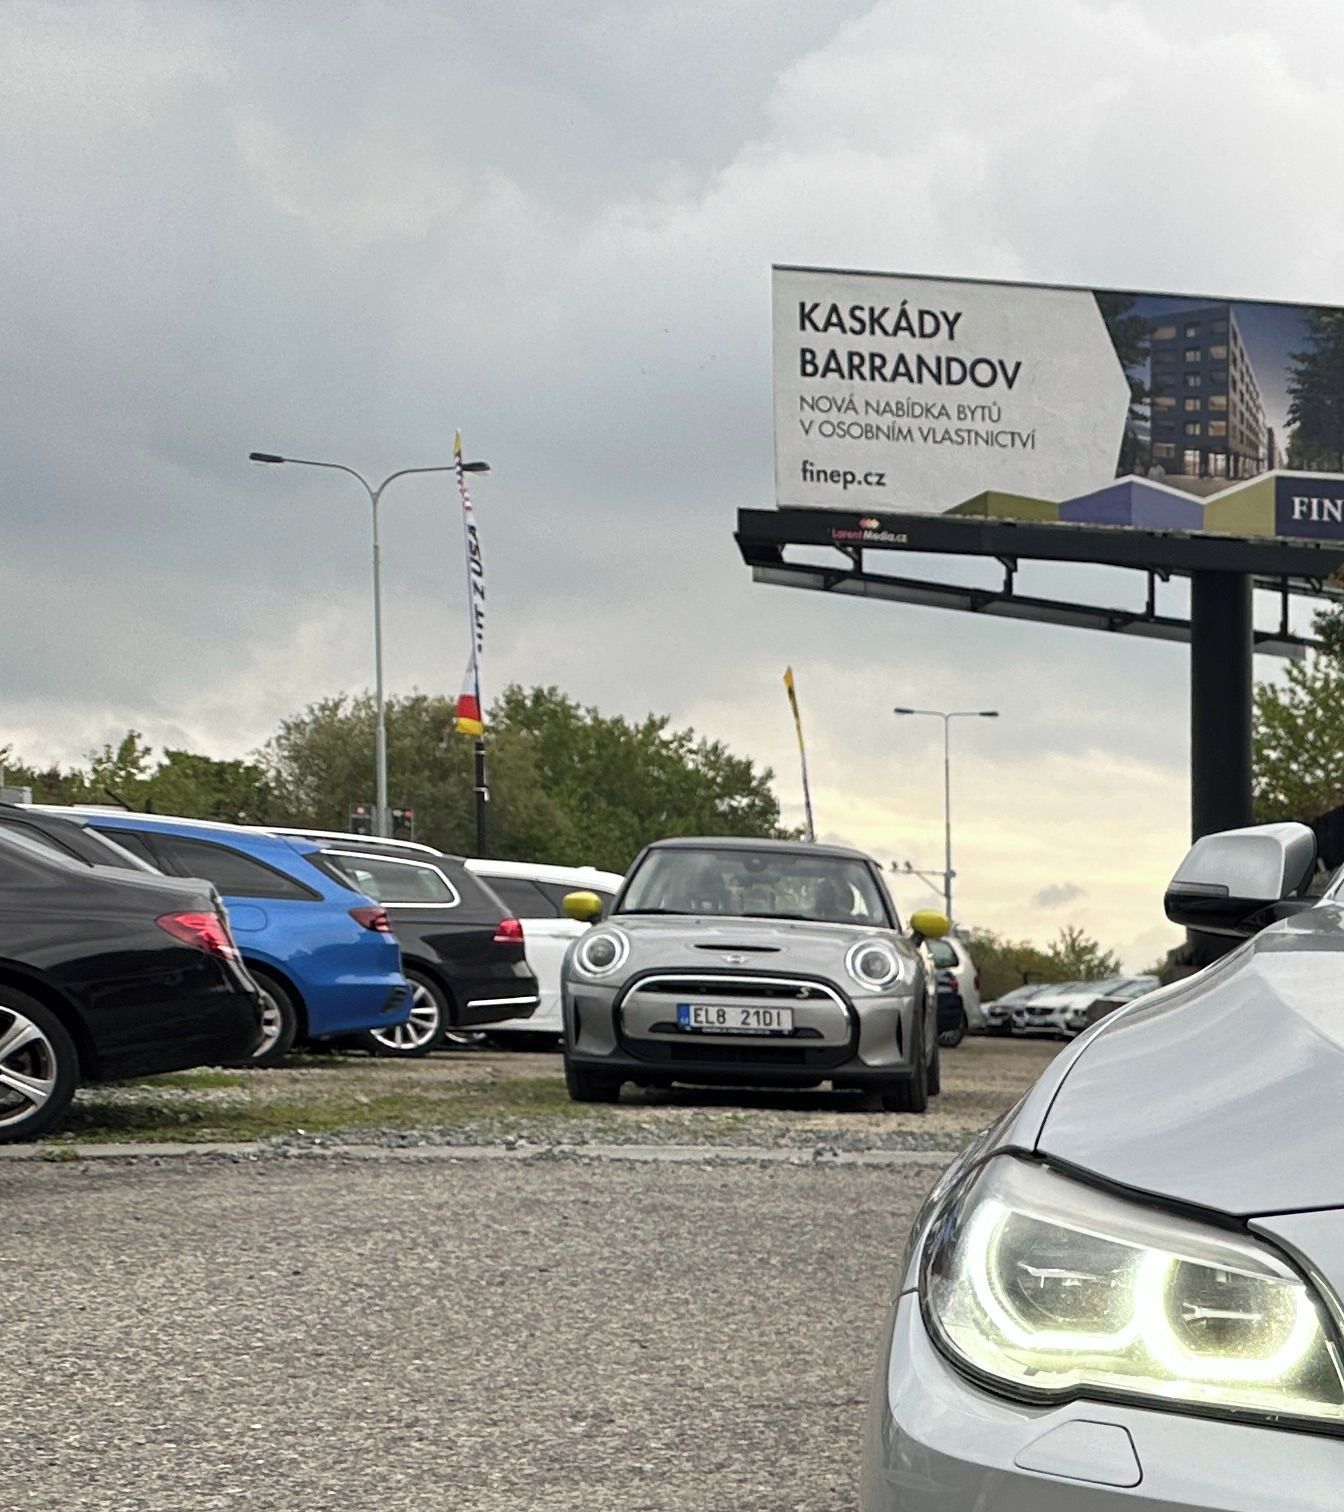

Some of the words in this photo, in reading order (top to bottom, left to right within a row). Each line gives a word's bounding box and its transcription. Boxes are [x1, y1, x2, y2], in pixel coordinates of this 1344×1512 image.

[798, 299, 963, 341] KASKÁDY
[799, 347, 1023, 390] BARRANDOV
[799, 393, 859, 415] NOVÁ
[864, 396, 951, 420] NABÍDKA
[956, 400, 1002, 423] BYTŮ
[799, 419, 814, 436] V
[818, 420, 914, 443] OSOBNÍM
[918, 426, 1036, 450] VLASTNICTVÍ
[800, 459, 887, 490] finep.cz
[693, 1007, 726, 1025] EL8
